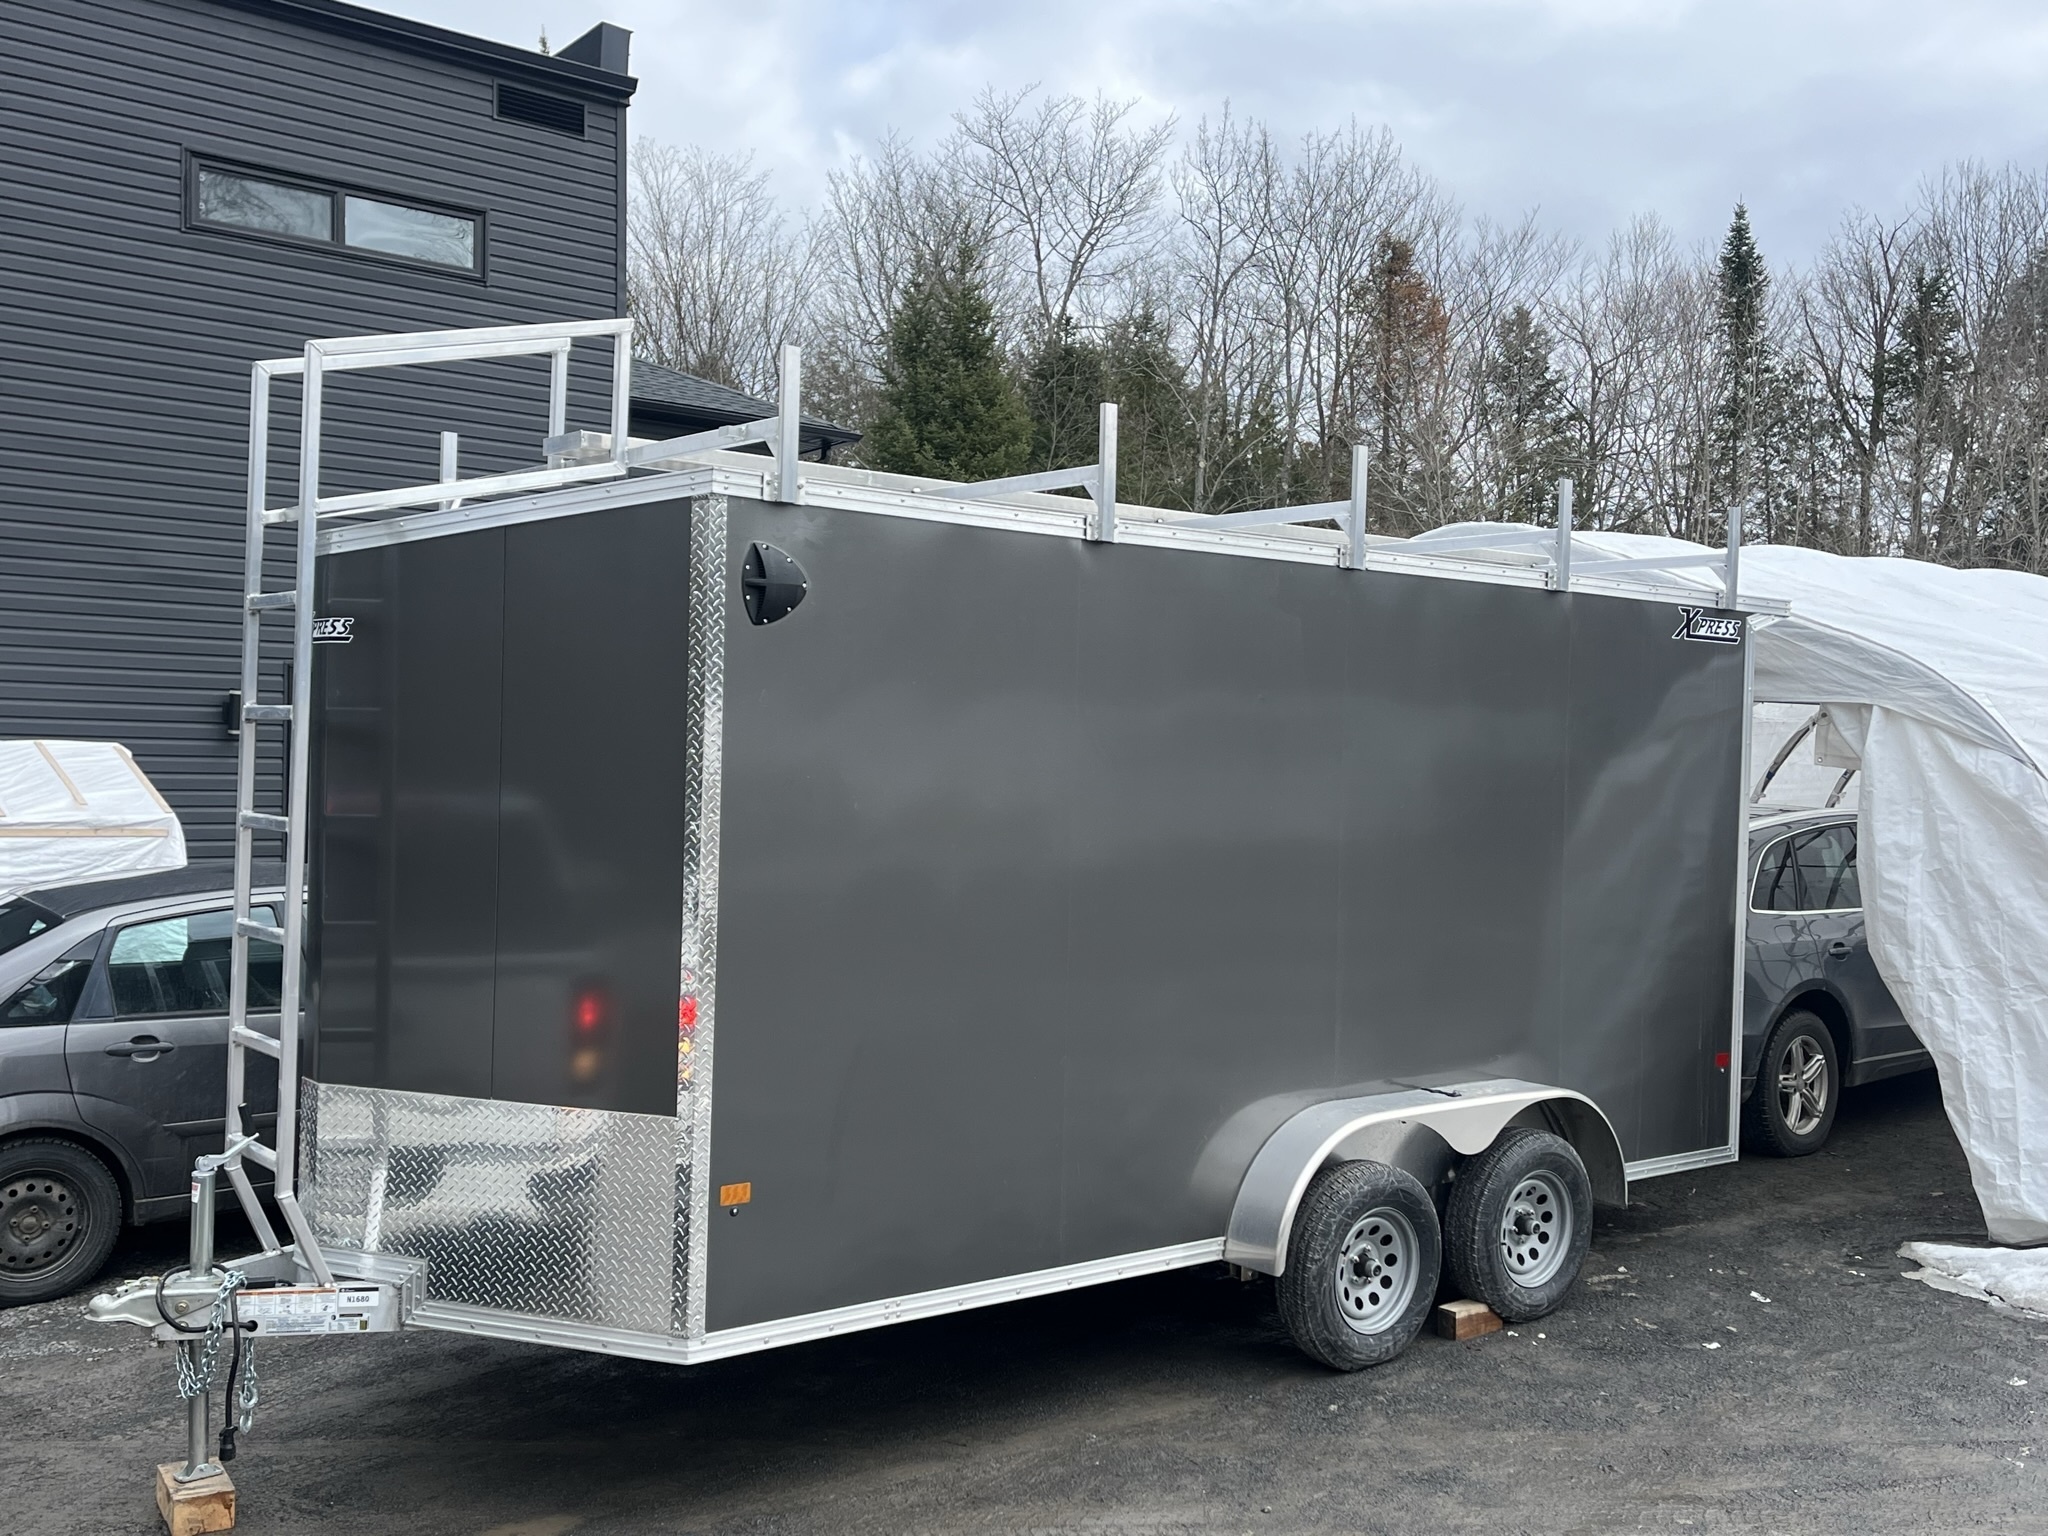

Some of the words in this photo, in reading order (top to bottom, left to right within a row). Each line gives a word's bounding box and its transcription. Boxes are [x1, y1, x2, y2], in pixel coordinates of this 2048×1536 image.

[313, 617, 354, 641] PRESS
[1672, 606, 1742, 644] XPRESS
[346, 1295, 370, 1303] N1680
